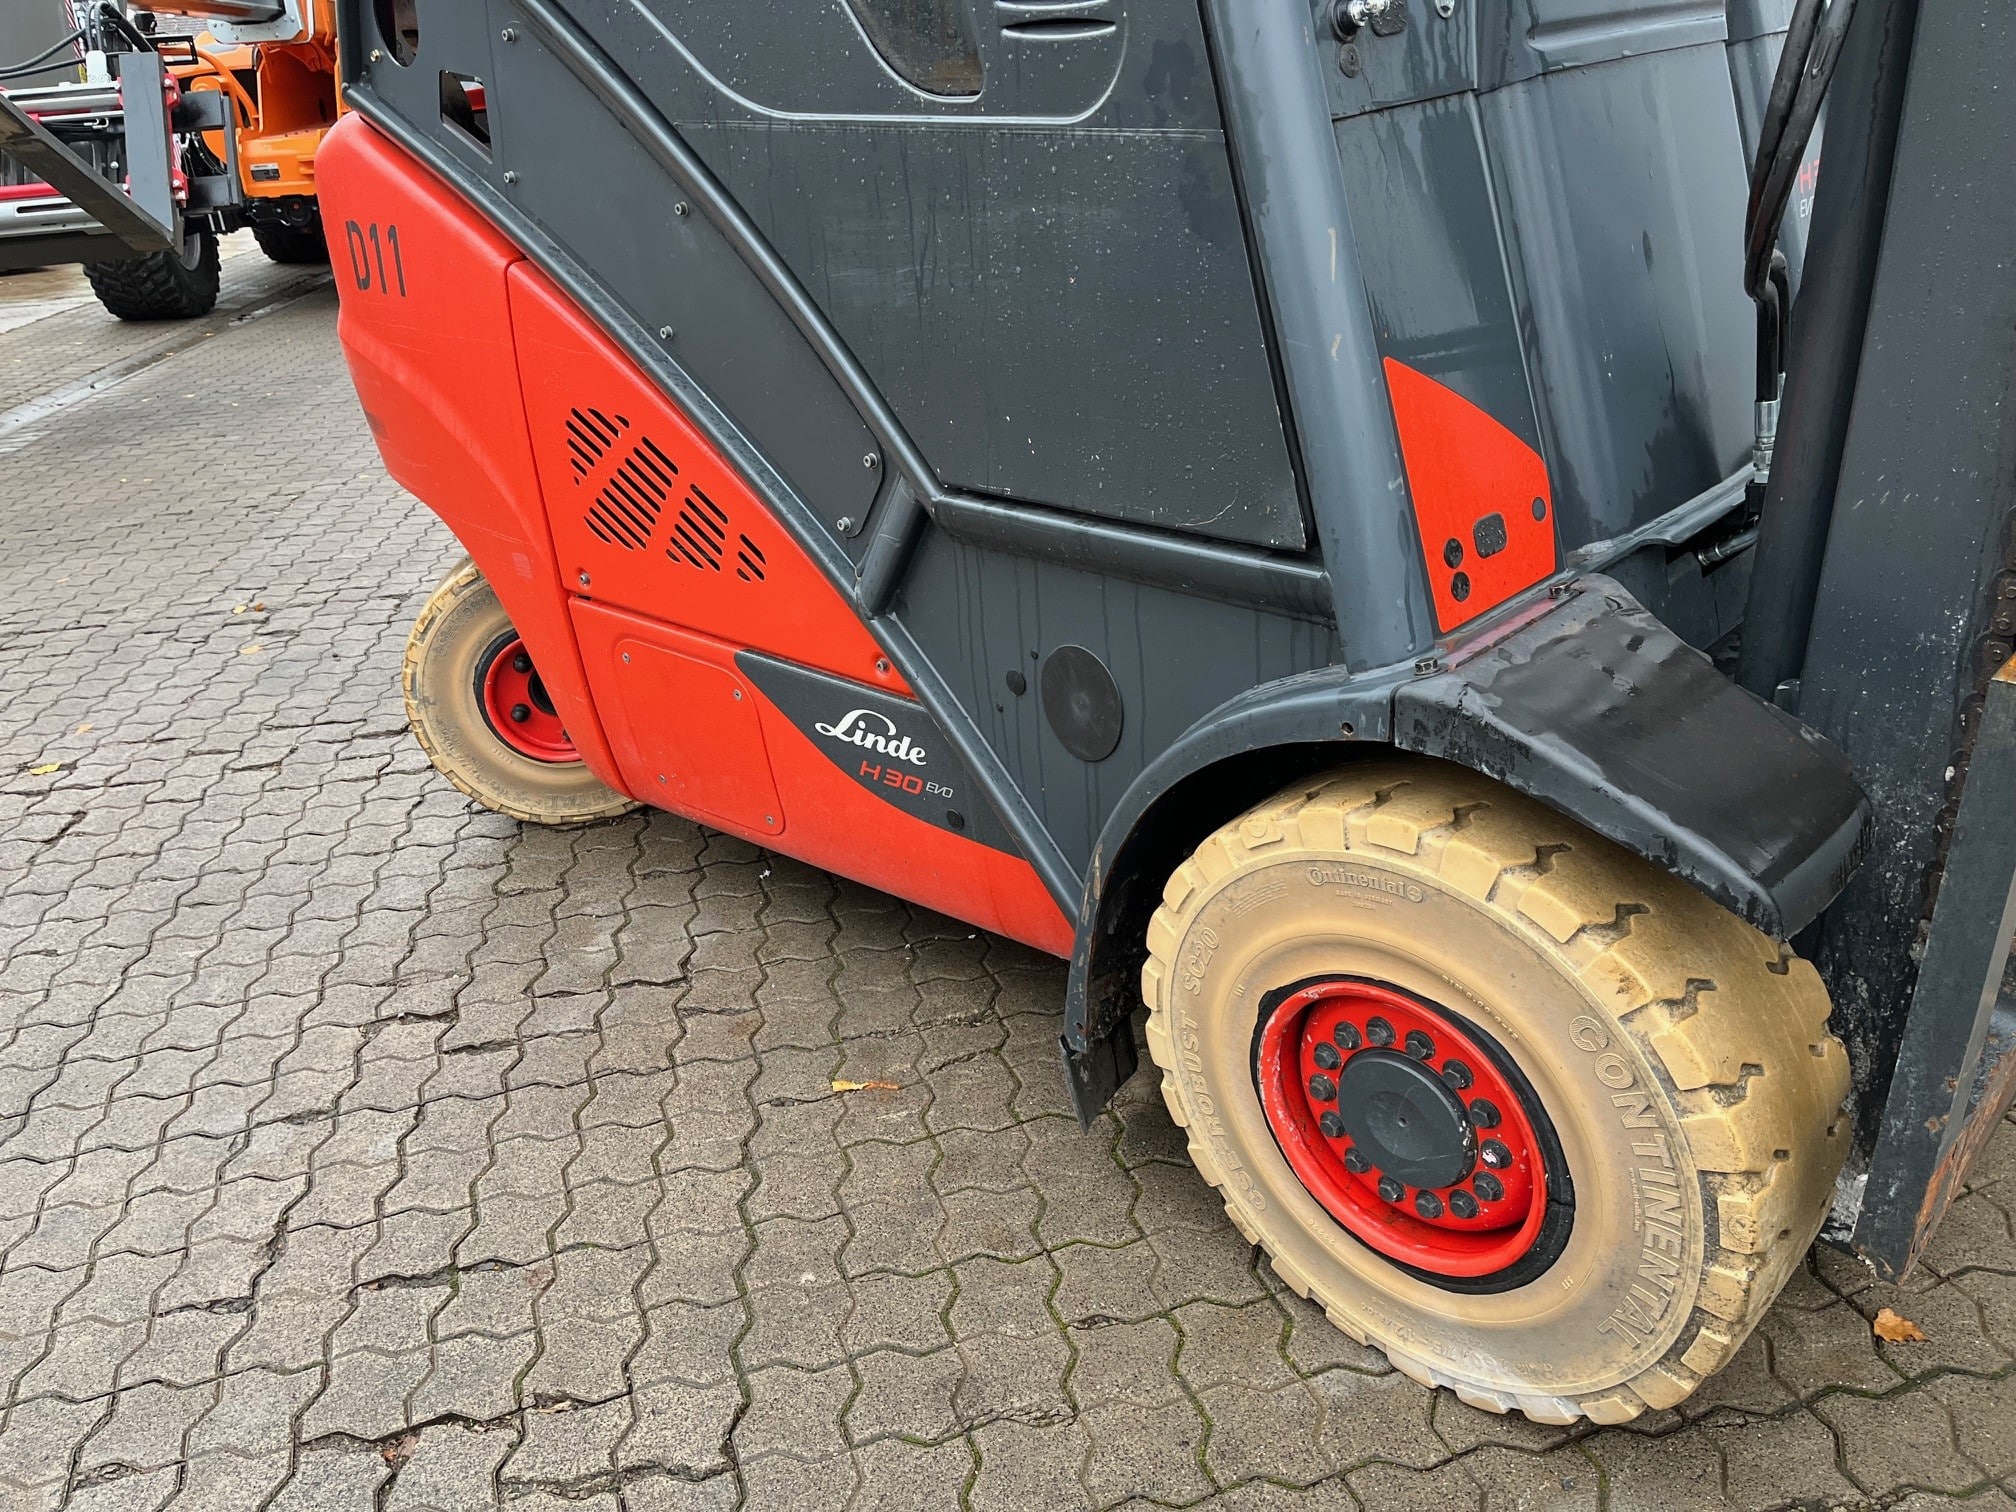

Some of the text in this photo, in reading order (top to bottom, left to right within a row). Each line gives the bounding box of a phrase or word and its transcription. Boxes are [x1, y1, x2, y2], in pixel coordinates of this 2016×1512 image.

[345, 219, 406, 298] D11
[814, 709, 927, 766] Linde
[925, 781, 954, 799] EVO
[1306, 866, 1406, 898] Continental
[1182, 927, 1219, 996] SC20
[1180, 1009, 1226, 1138] ROBUST
[1568, 1015, 1685, 1348] CONTINENTAL
